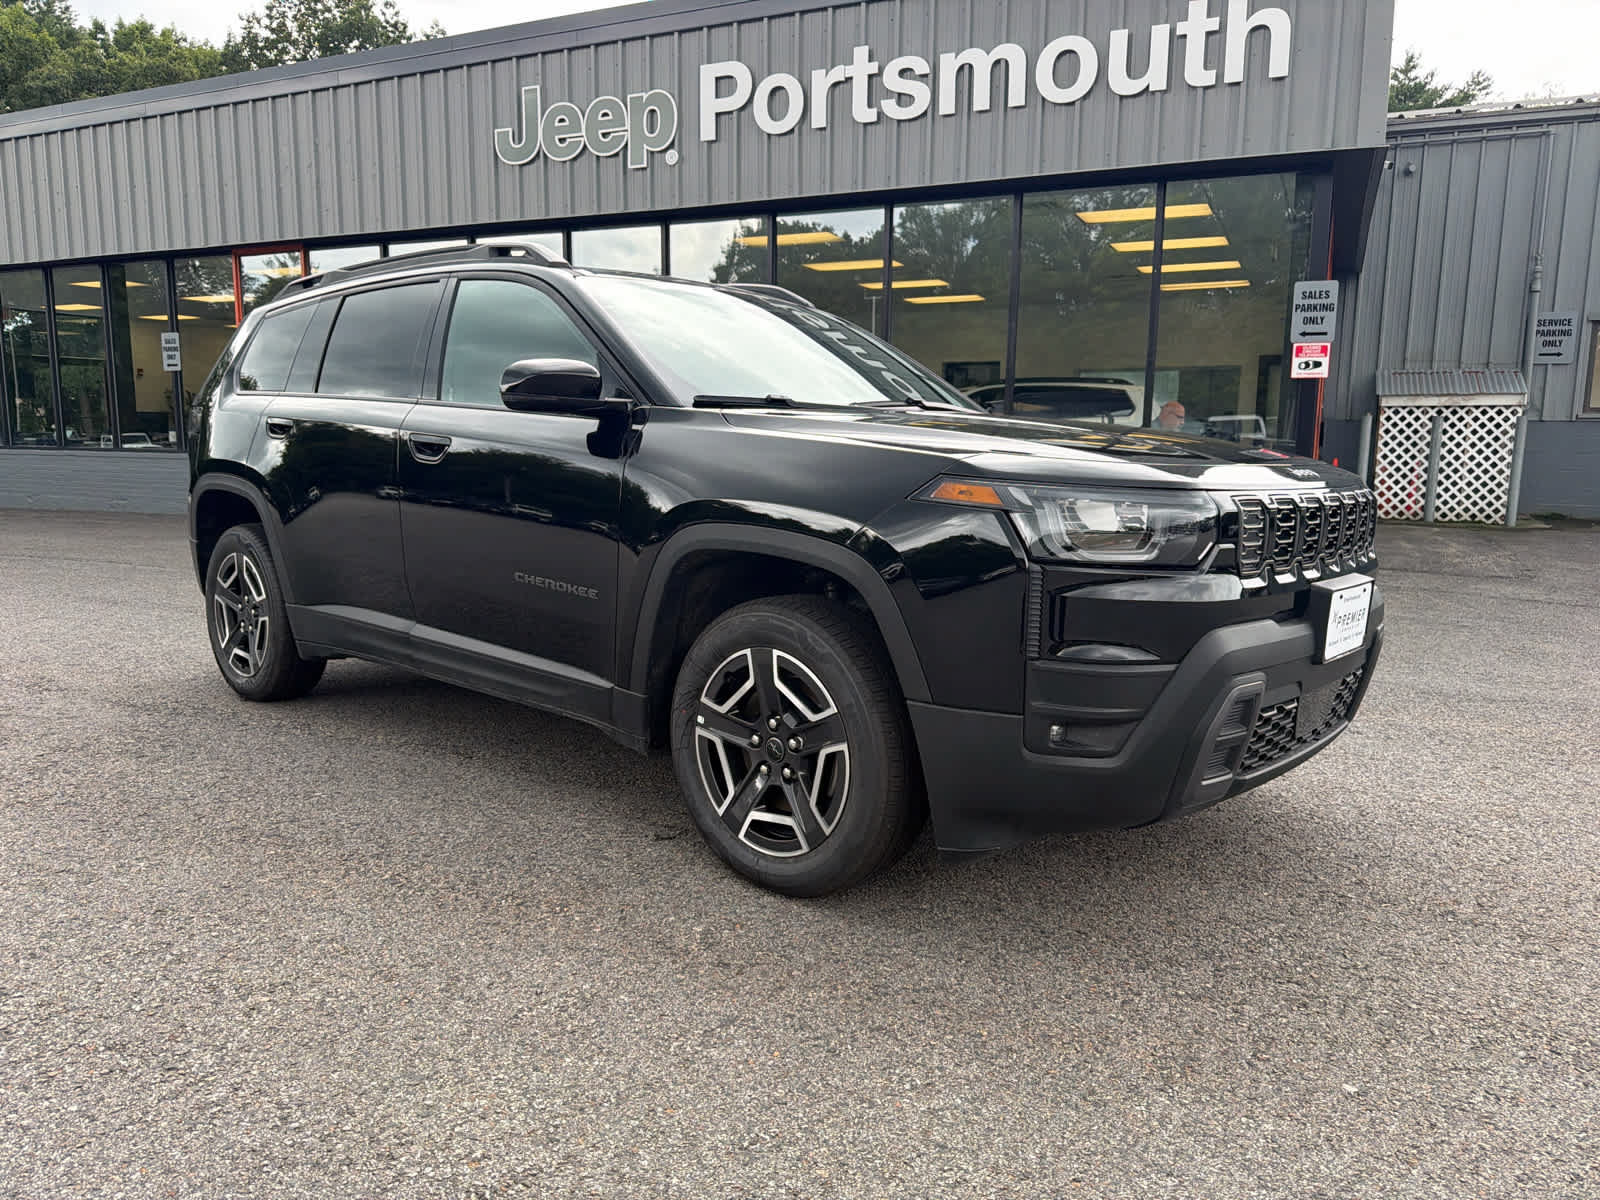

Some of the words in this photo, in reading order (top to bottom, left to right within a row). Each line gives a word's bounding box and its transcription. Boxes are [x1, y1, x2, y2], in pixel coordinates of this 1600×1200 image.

[494, 85, 678, 168] Jeep
[700, 0, 1292, 142] Portsmouth
[1301, 290, 1330, 300] SALES
[1295, 303, 1335, 312] PARKING
[1302, 316, 1325, 325] ONLY
[1536, 318, 1573, 327] SERVICE
[1535, 328, 1573, 337] PARKING
[1542, 339, 1563, 348] ONLY
[514, 572, 599, 600] CHEROKEE
[1336, 607, 1366, 628] PREMIER
